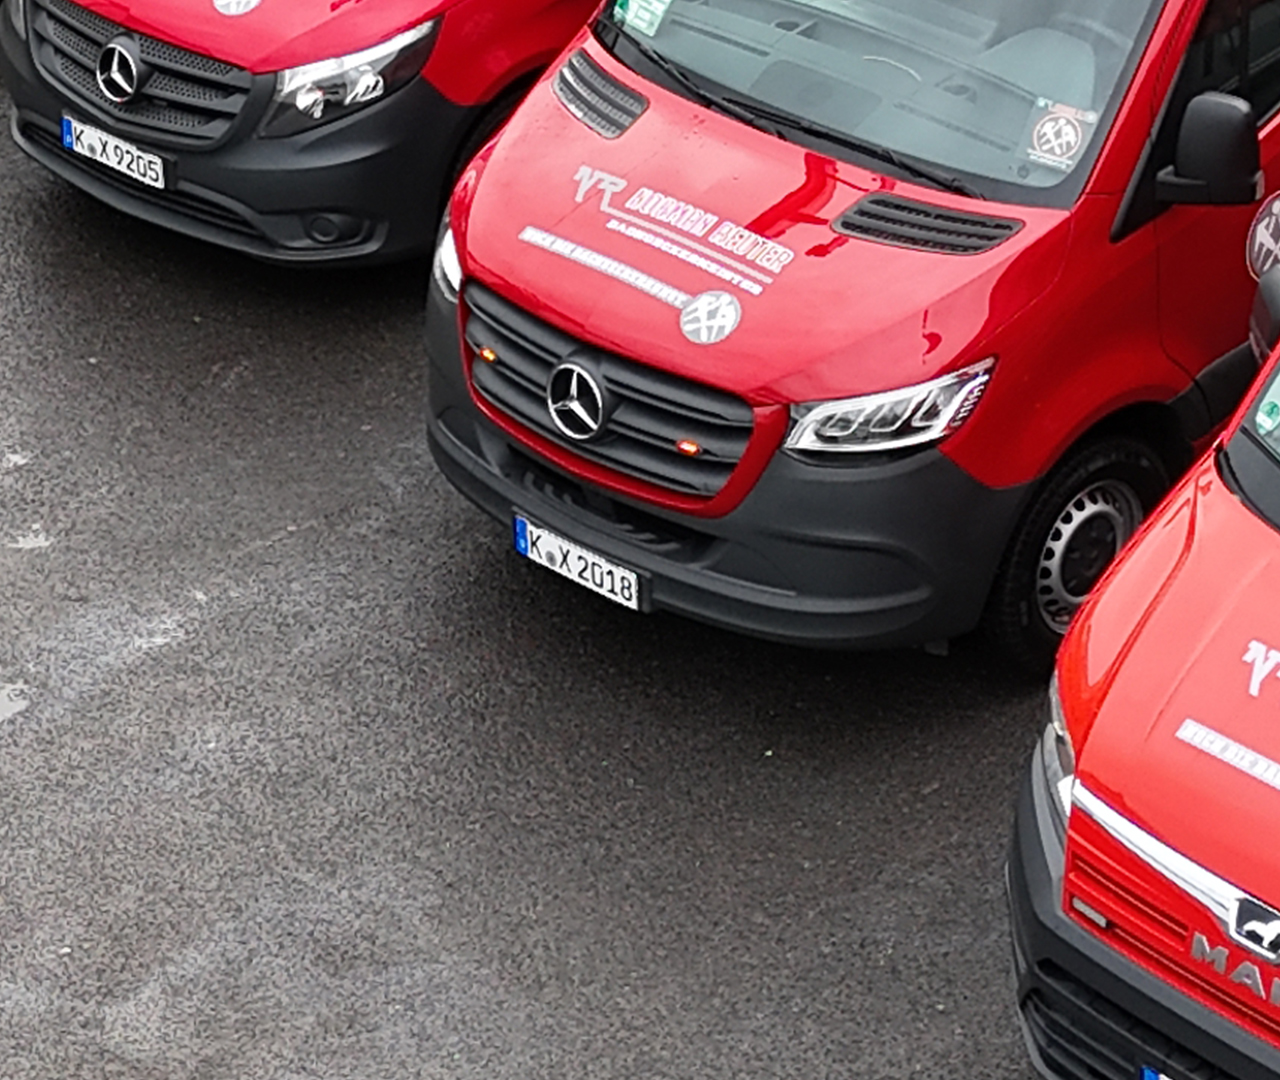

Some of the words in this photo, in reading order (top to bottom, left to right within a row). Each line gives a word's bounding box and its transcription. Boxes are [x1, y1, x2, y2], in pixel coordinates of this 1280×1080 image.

[73, 125, 85, 151] K
[98, 136, 111, 161] X
[112, 143, 161, 184] 9205
[708, 220, 796, 275] REUTER
[528, 528, 543, 560] K
[558, 543, 572, 574] X
[576, 554, 634, 603] 2018
